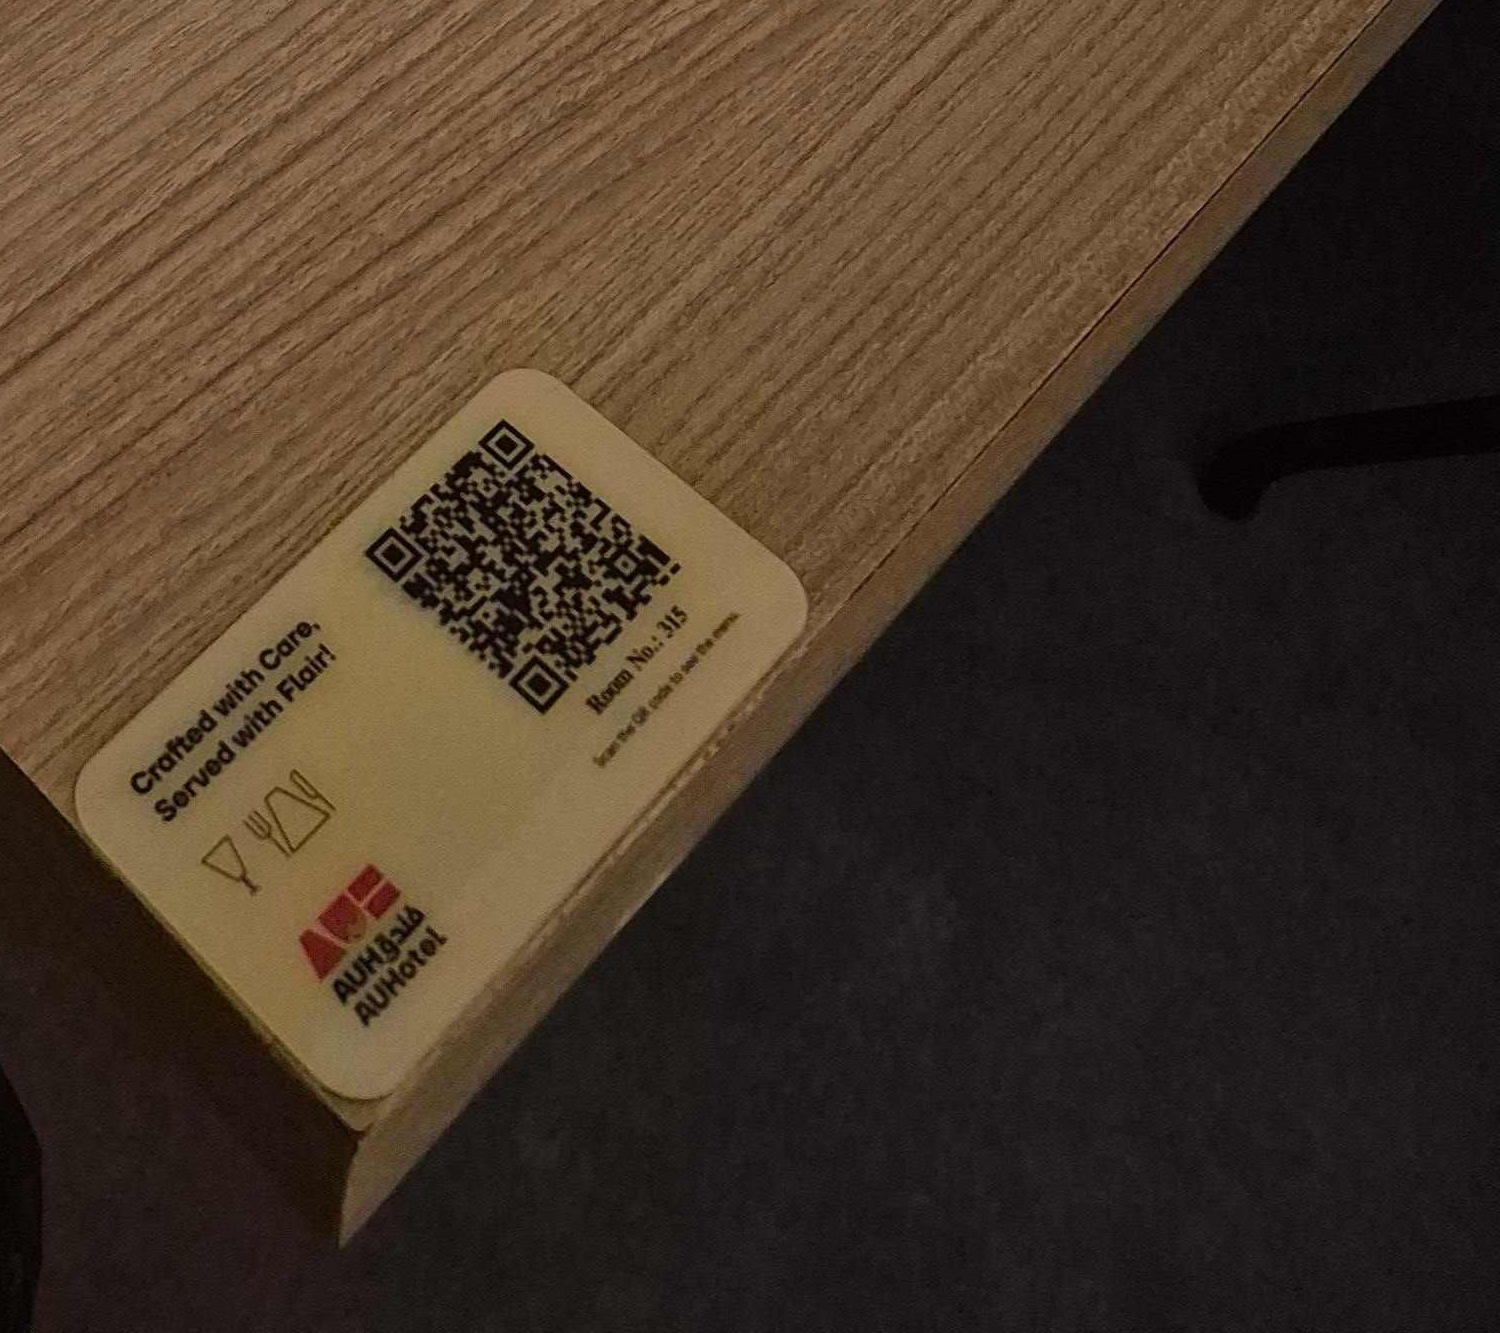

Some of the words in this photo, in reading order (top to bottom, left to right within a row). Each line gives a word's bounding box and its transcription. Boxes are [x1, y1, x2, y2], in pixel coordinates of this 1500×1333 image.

[129, 708, 219, 795] Crafted
[212, 667, 266, 718] with
[258, 620, 322, 671] Care,
[585, 668, 635, 716] Room
[656, 604, 688, 639] 315
[153, 739, 238, 823] Served
[230, 698, 285, 749] with
[275, 642, 338, 703] Flair!
[332, 943, 385, 1007] AUH
[353, 924, 449, 1028] AUHotel
